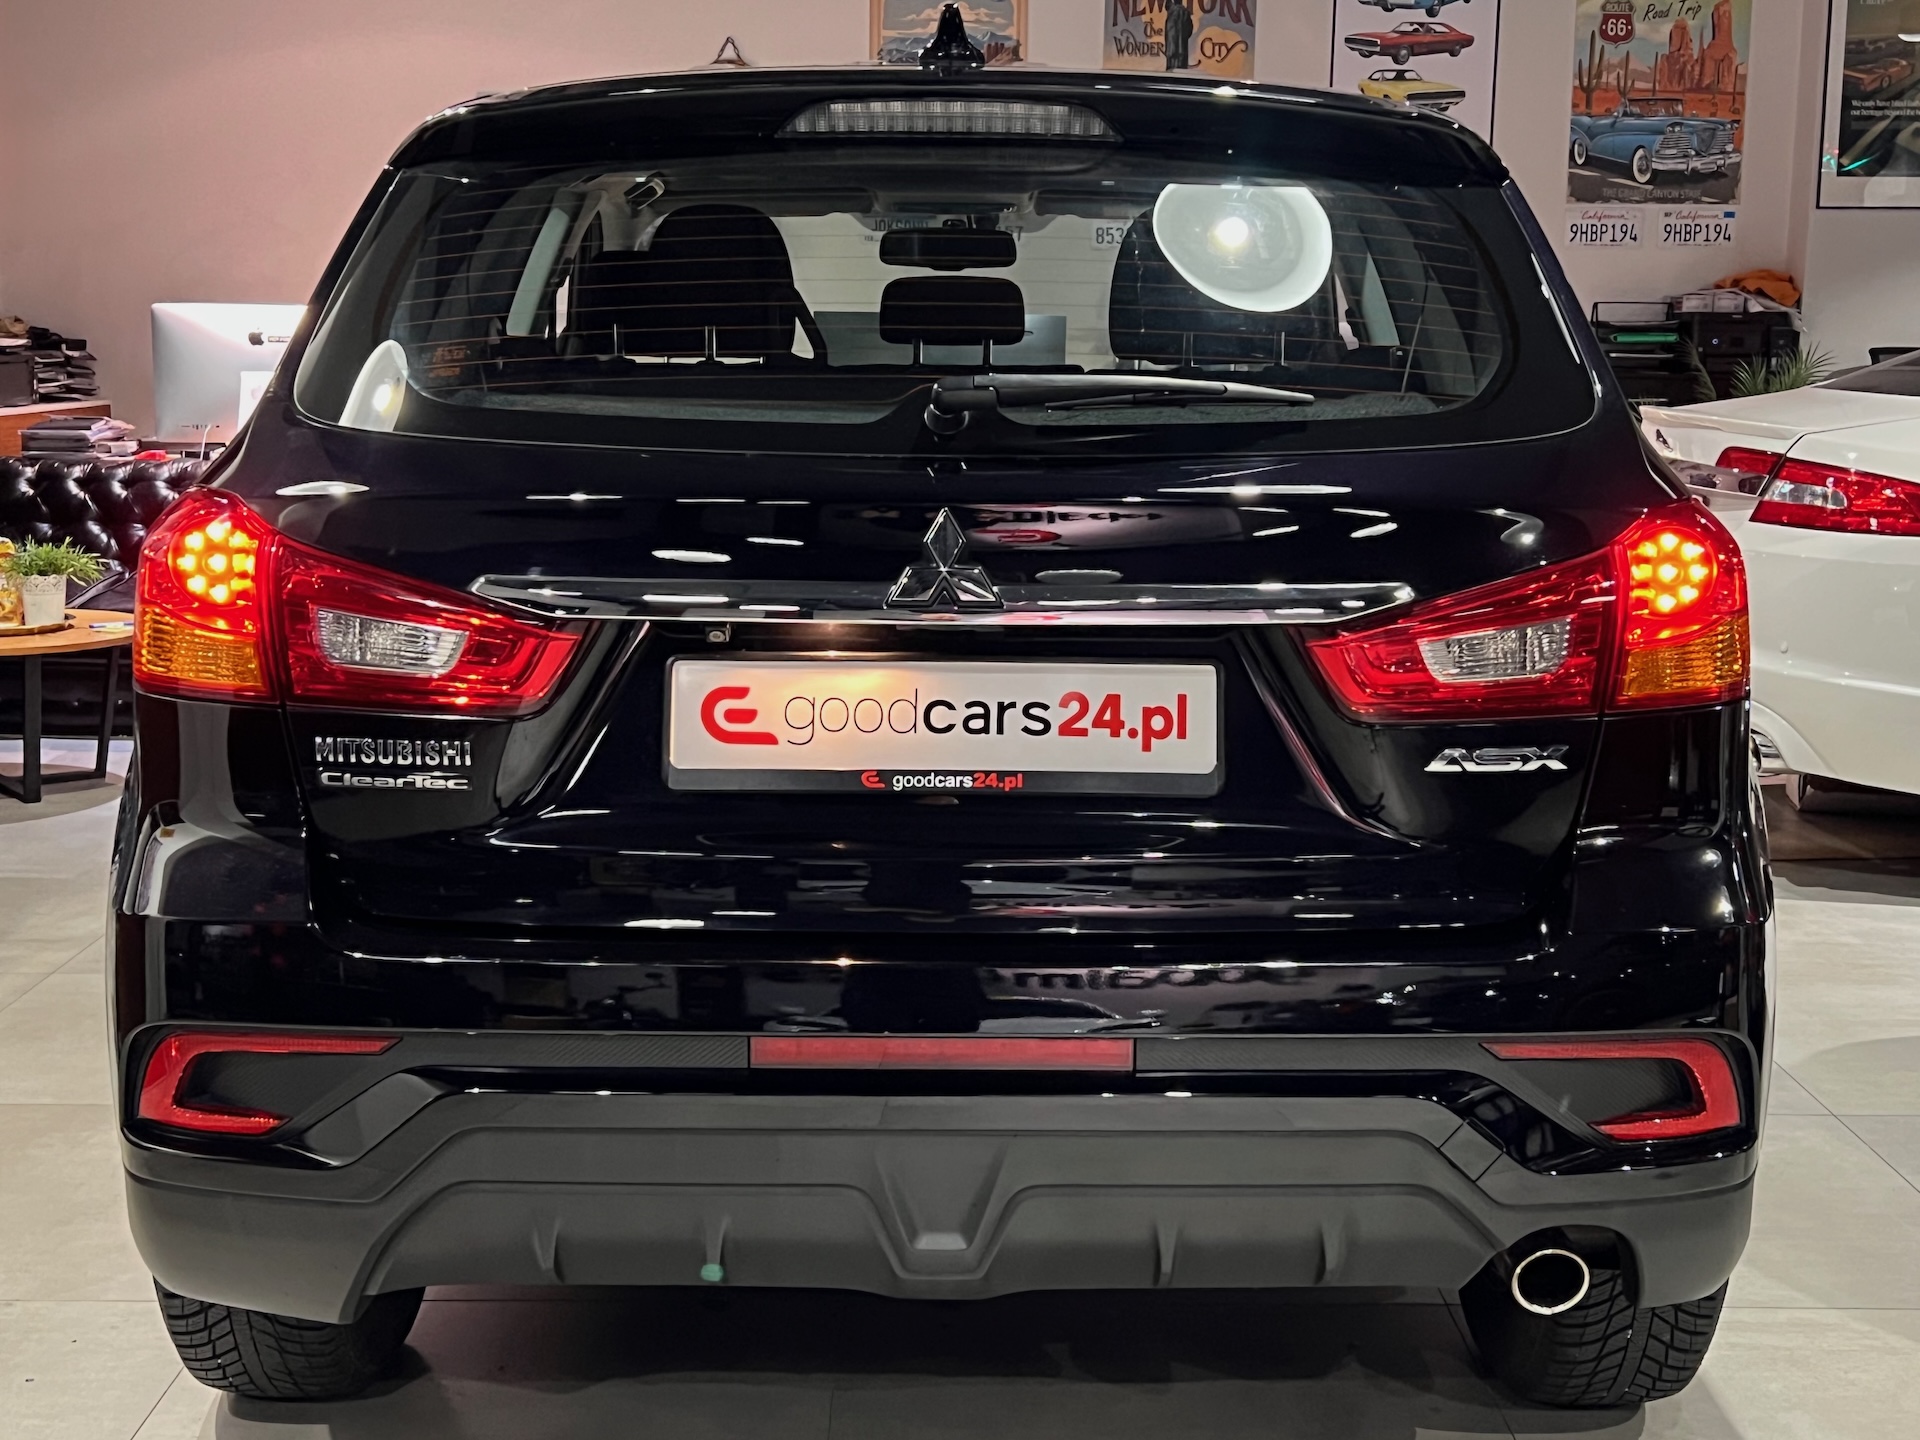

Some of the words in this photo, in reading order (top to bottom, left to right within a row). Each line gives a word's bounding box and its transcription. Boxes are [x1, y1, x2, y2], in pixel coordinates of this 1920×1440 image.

[1605, 2, 1630, 12] ROUTE
[1642, 2, 1674, 22] Road
[1677, 0, 1702, 20] Trip
[1607, 18, 1627, 36] 66
[1569, 223, 1638, 243] 9HBP194
[1663, 223, 1731, 243] 9HBP194
[784, 688, 1188, 753] goodcars24.pl
[315, 736, 472, 767] MITSUBISHI
[1424, 745, 1570, 773] ASX
[320, 772, 469, 790] ClearTec
[892, 772, 1024, 792] goodcars24.pl
